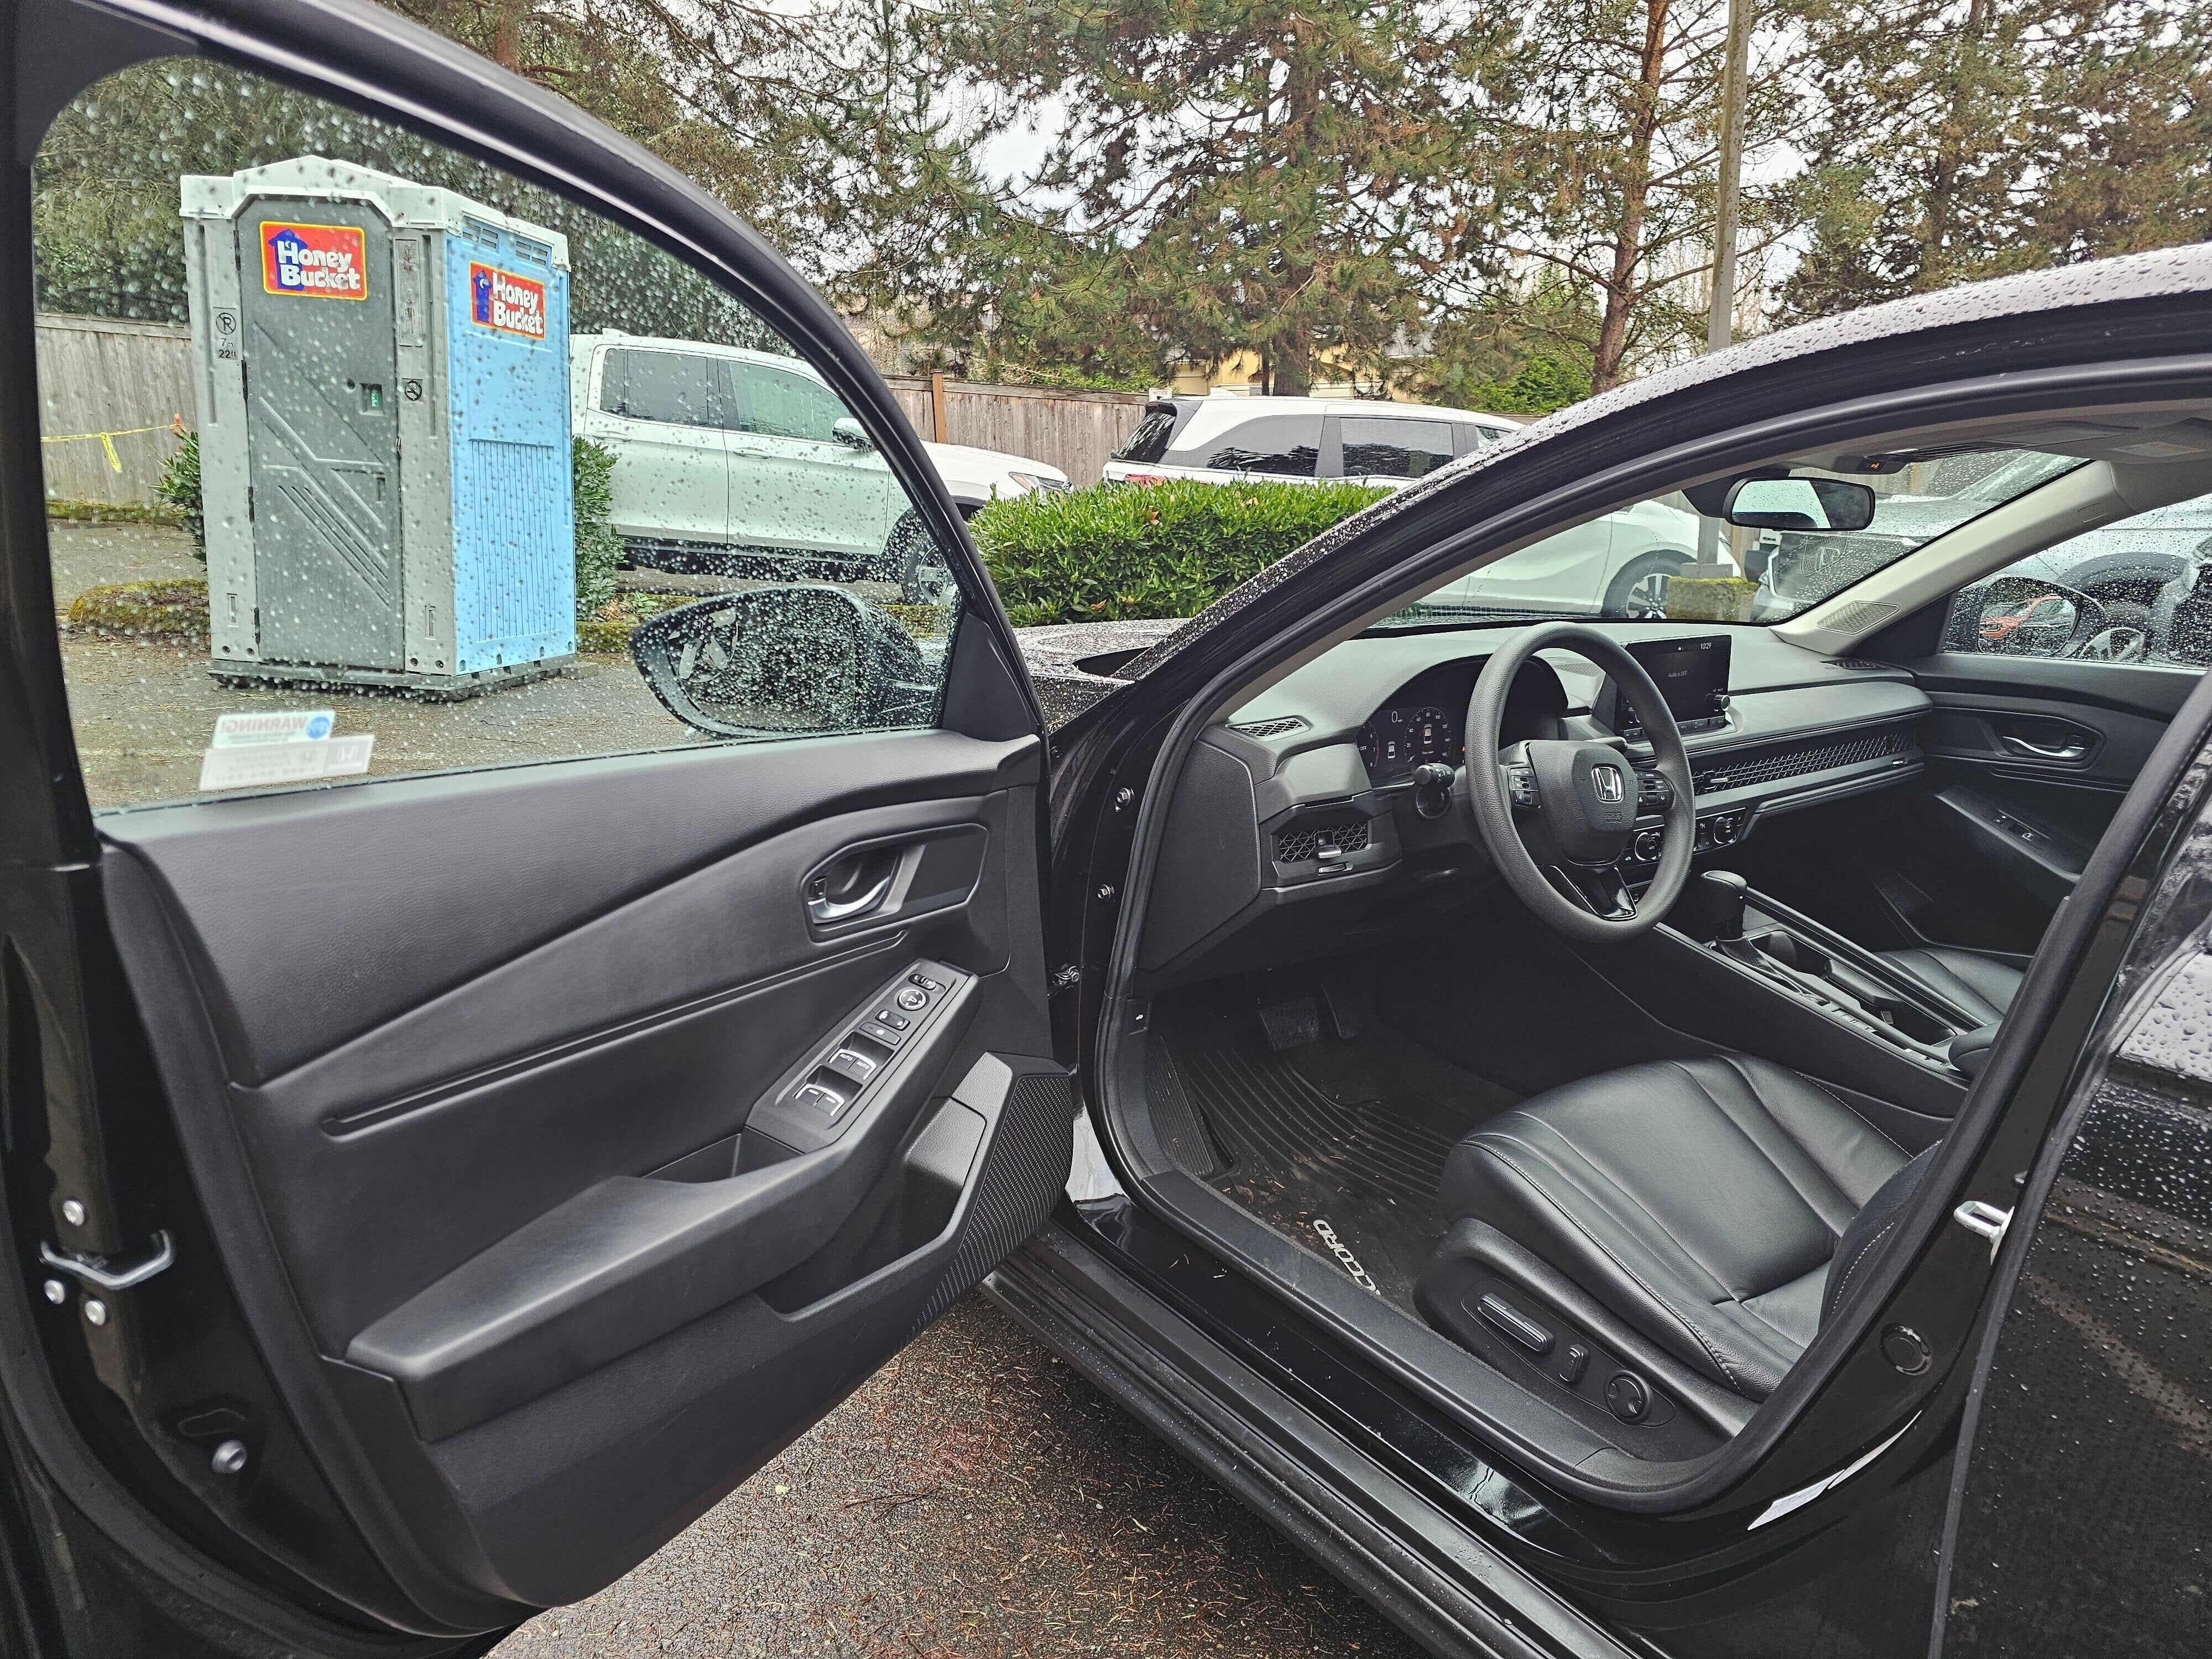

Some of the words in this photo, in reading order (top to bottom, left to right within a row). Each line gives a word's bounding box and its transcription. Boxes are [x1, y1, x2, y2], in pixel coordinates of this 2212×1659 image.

[277, 240, 352, 273] Honey
[280, 264, 361, 290] Bucket
[492, 272, 539, 314] Honey
[493, 300, 544, 335] Bucket
[1391, 711, 1398, 723] 0
[856, 1061, 870, 1070] AUTO
[1313, 1219, 1381, 1295] CCORD
